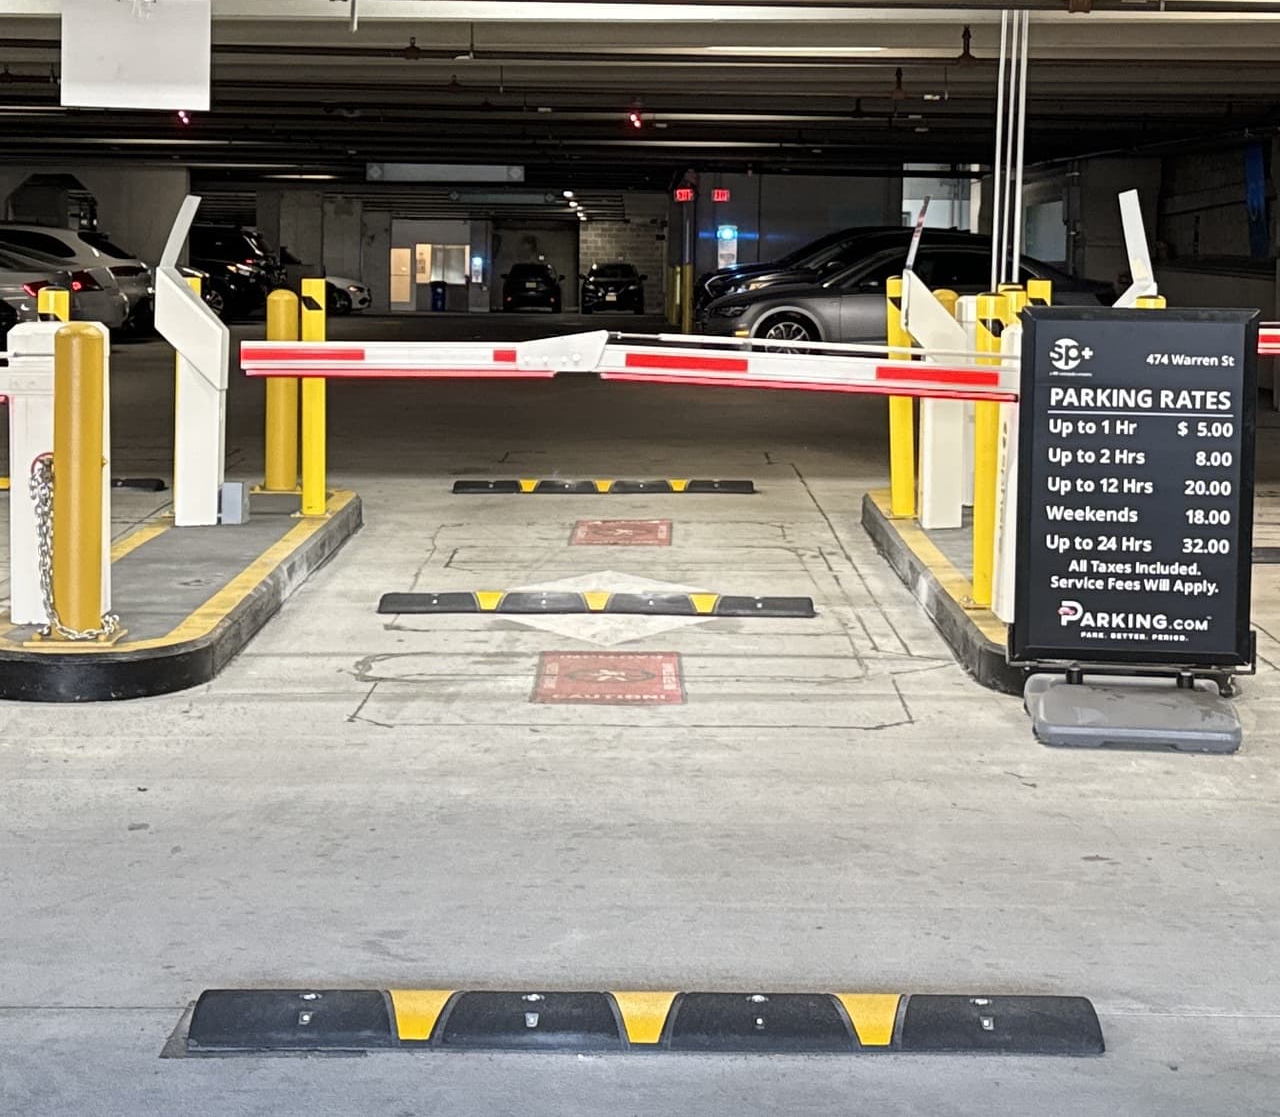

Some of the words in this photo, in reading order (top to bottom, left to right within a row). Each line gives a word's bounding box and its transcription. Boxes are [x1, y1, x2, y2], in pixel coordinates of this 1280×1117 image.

[1146, 353, 1169, 365] 474
[1171, 354, 1219, 367] Warren
[1221, 355, 1235, 367] St
[1050, 387, 1153, 408] PARKING
[1159, 390, 1232, 410] RATES
[1048, 418, 1073, 438] Up
[1077, 420, 1096, 434] to
[1101, 420, 1110, 435] 1
[1115, 420, 1138, 435] Hr
[1177, 420, 1189, 437] $
[1196, 422, 1234, 438] 5.00
[1048, 447, 1072, 467] Up
[1076, 449, 1096, 463] to
[1099, 449, 1111, 464] 2
[1114, 449, 1146, 465] Hrs
[1195, 451, 1233, 467] 8.00
[1047, 476, 1071, 496] Up
[1075, 478, 1095, 493] to
[1100, 478, 1119, 493] 12
[1123, 478, 1154, 494] Hrs
[1184, 480, 1232, 496] 20.00
[1045, 505, 1139, 523] Weekends
[1185, 509, 1231, 525] 18.00
[1045, 534, 1070, 553] Up
[1074, 535, 1094, 550] to
[1097, 536, 1118, 551] 24
[1121, 536, 1153, 552] Hrs
[1182, 538, 1230, 554] 32.00
[1068, 559, 1088, 572] All
[1090, 560, 1132, 574] Taxes
[1135, 561, 1202, 576] Included.
[1050, 575, 1104, 590] Service
[1108, 577, 1141, 591] Fees
[1144, 578, 1170, 592] Will
[1173, 579, 1219, 596] Apply.
